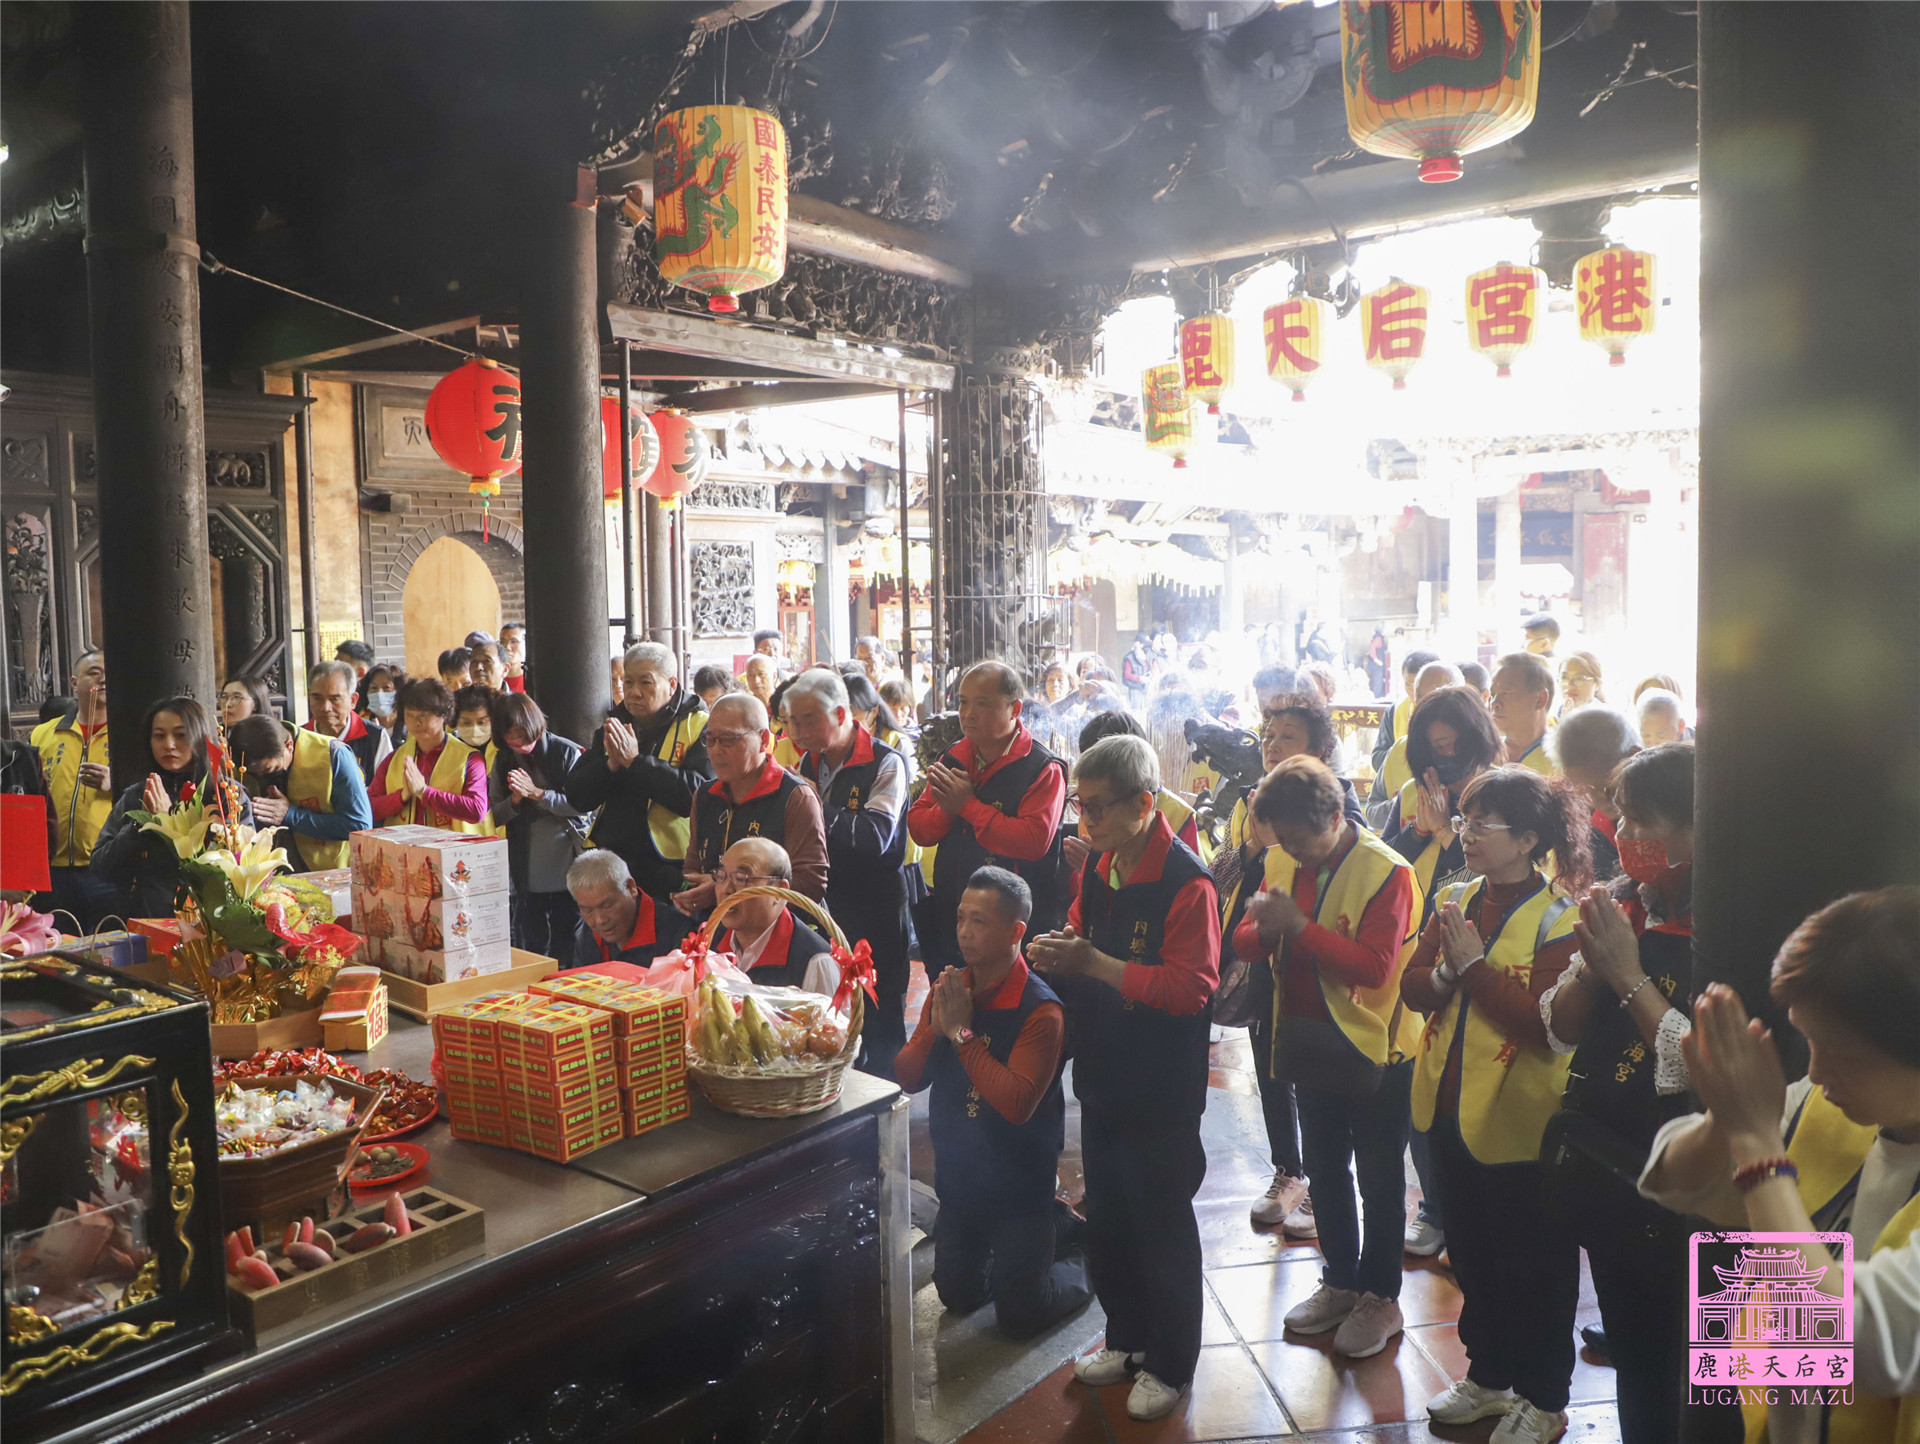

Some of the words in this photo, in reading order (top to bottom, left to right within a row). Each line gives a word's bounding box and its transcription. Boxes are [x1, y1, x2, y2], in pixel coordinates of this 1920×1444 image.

[752, 116, 779, 259] 國泰民安
[1366, 286, 1428, 361] 后
[1469, 266, 1539, 348] 宮
[1577, 250, 1652, 332] 港
[1264, 301, 1321, 377] 天
